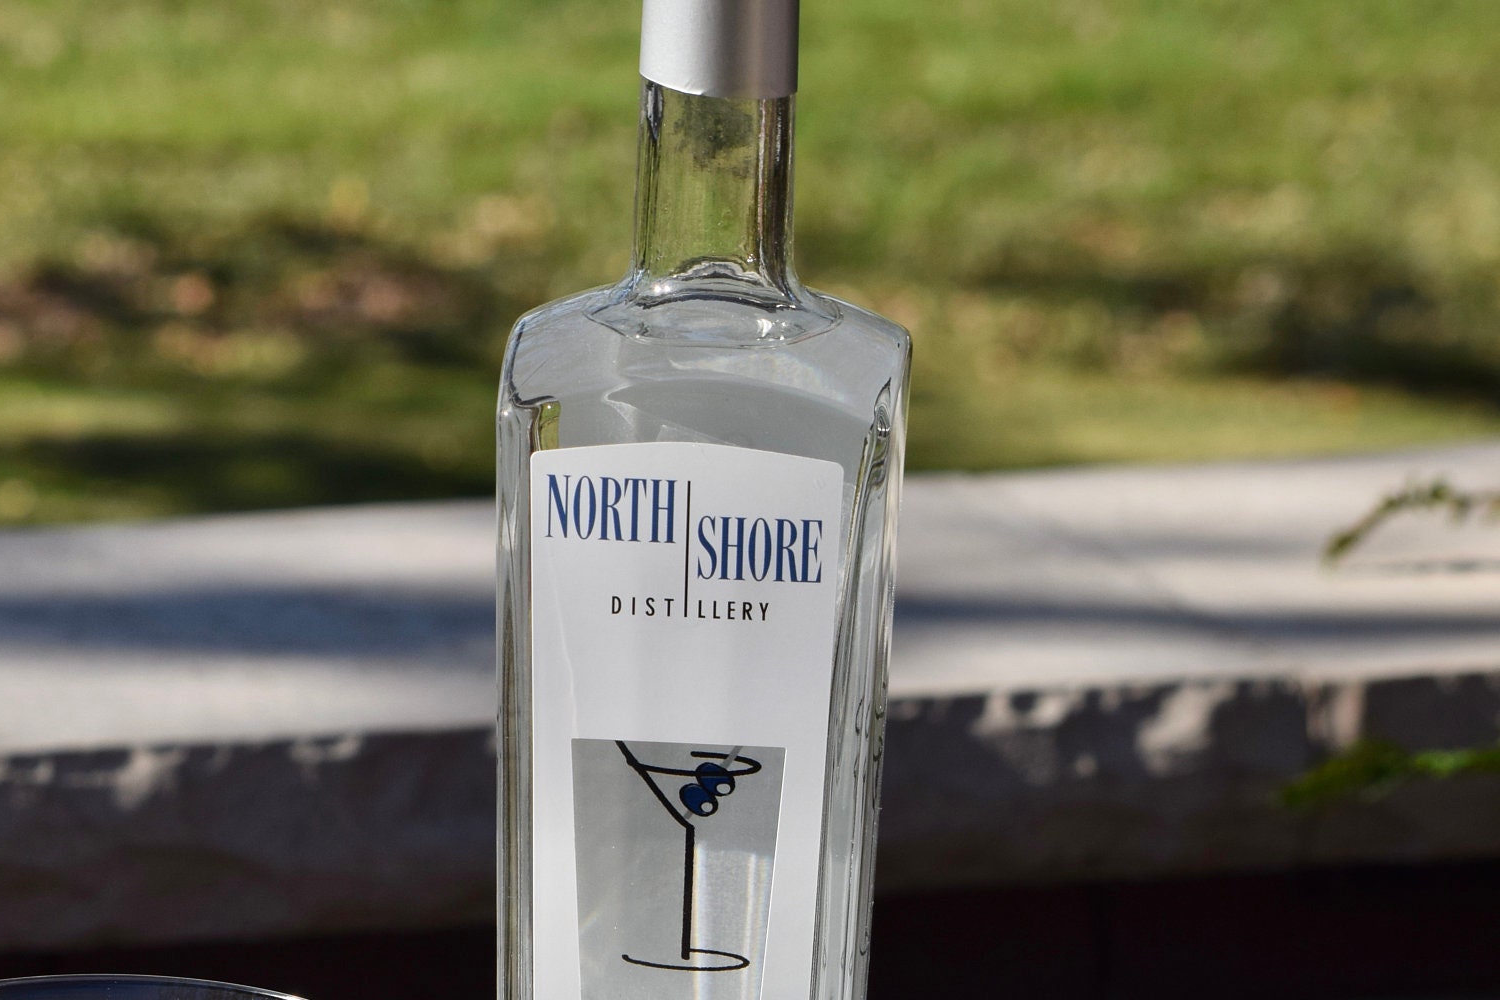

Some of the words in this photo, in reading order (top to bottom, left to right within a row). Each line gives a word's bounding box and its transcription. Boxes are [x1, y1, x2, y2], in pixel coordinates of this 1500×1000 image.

[545, 474, 677, 544] NORTH
[697, 515, 823, 583] SHORE
[611, 595, 770, 621] DISTILLERY
